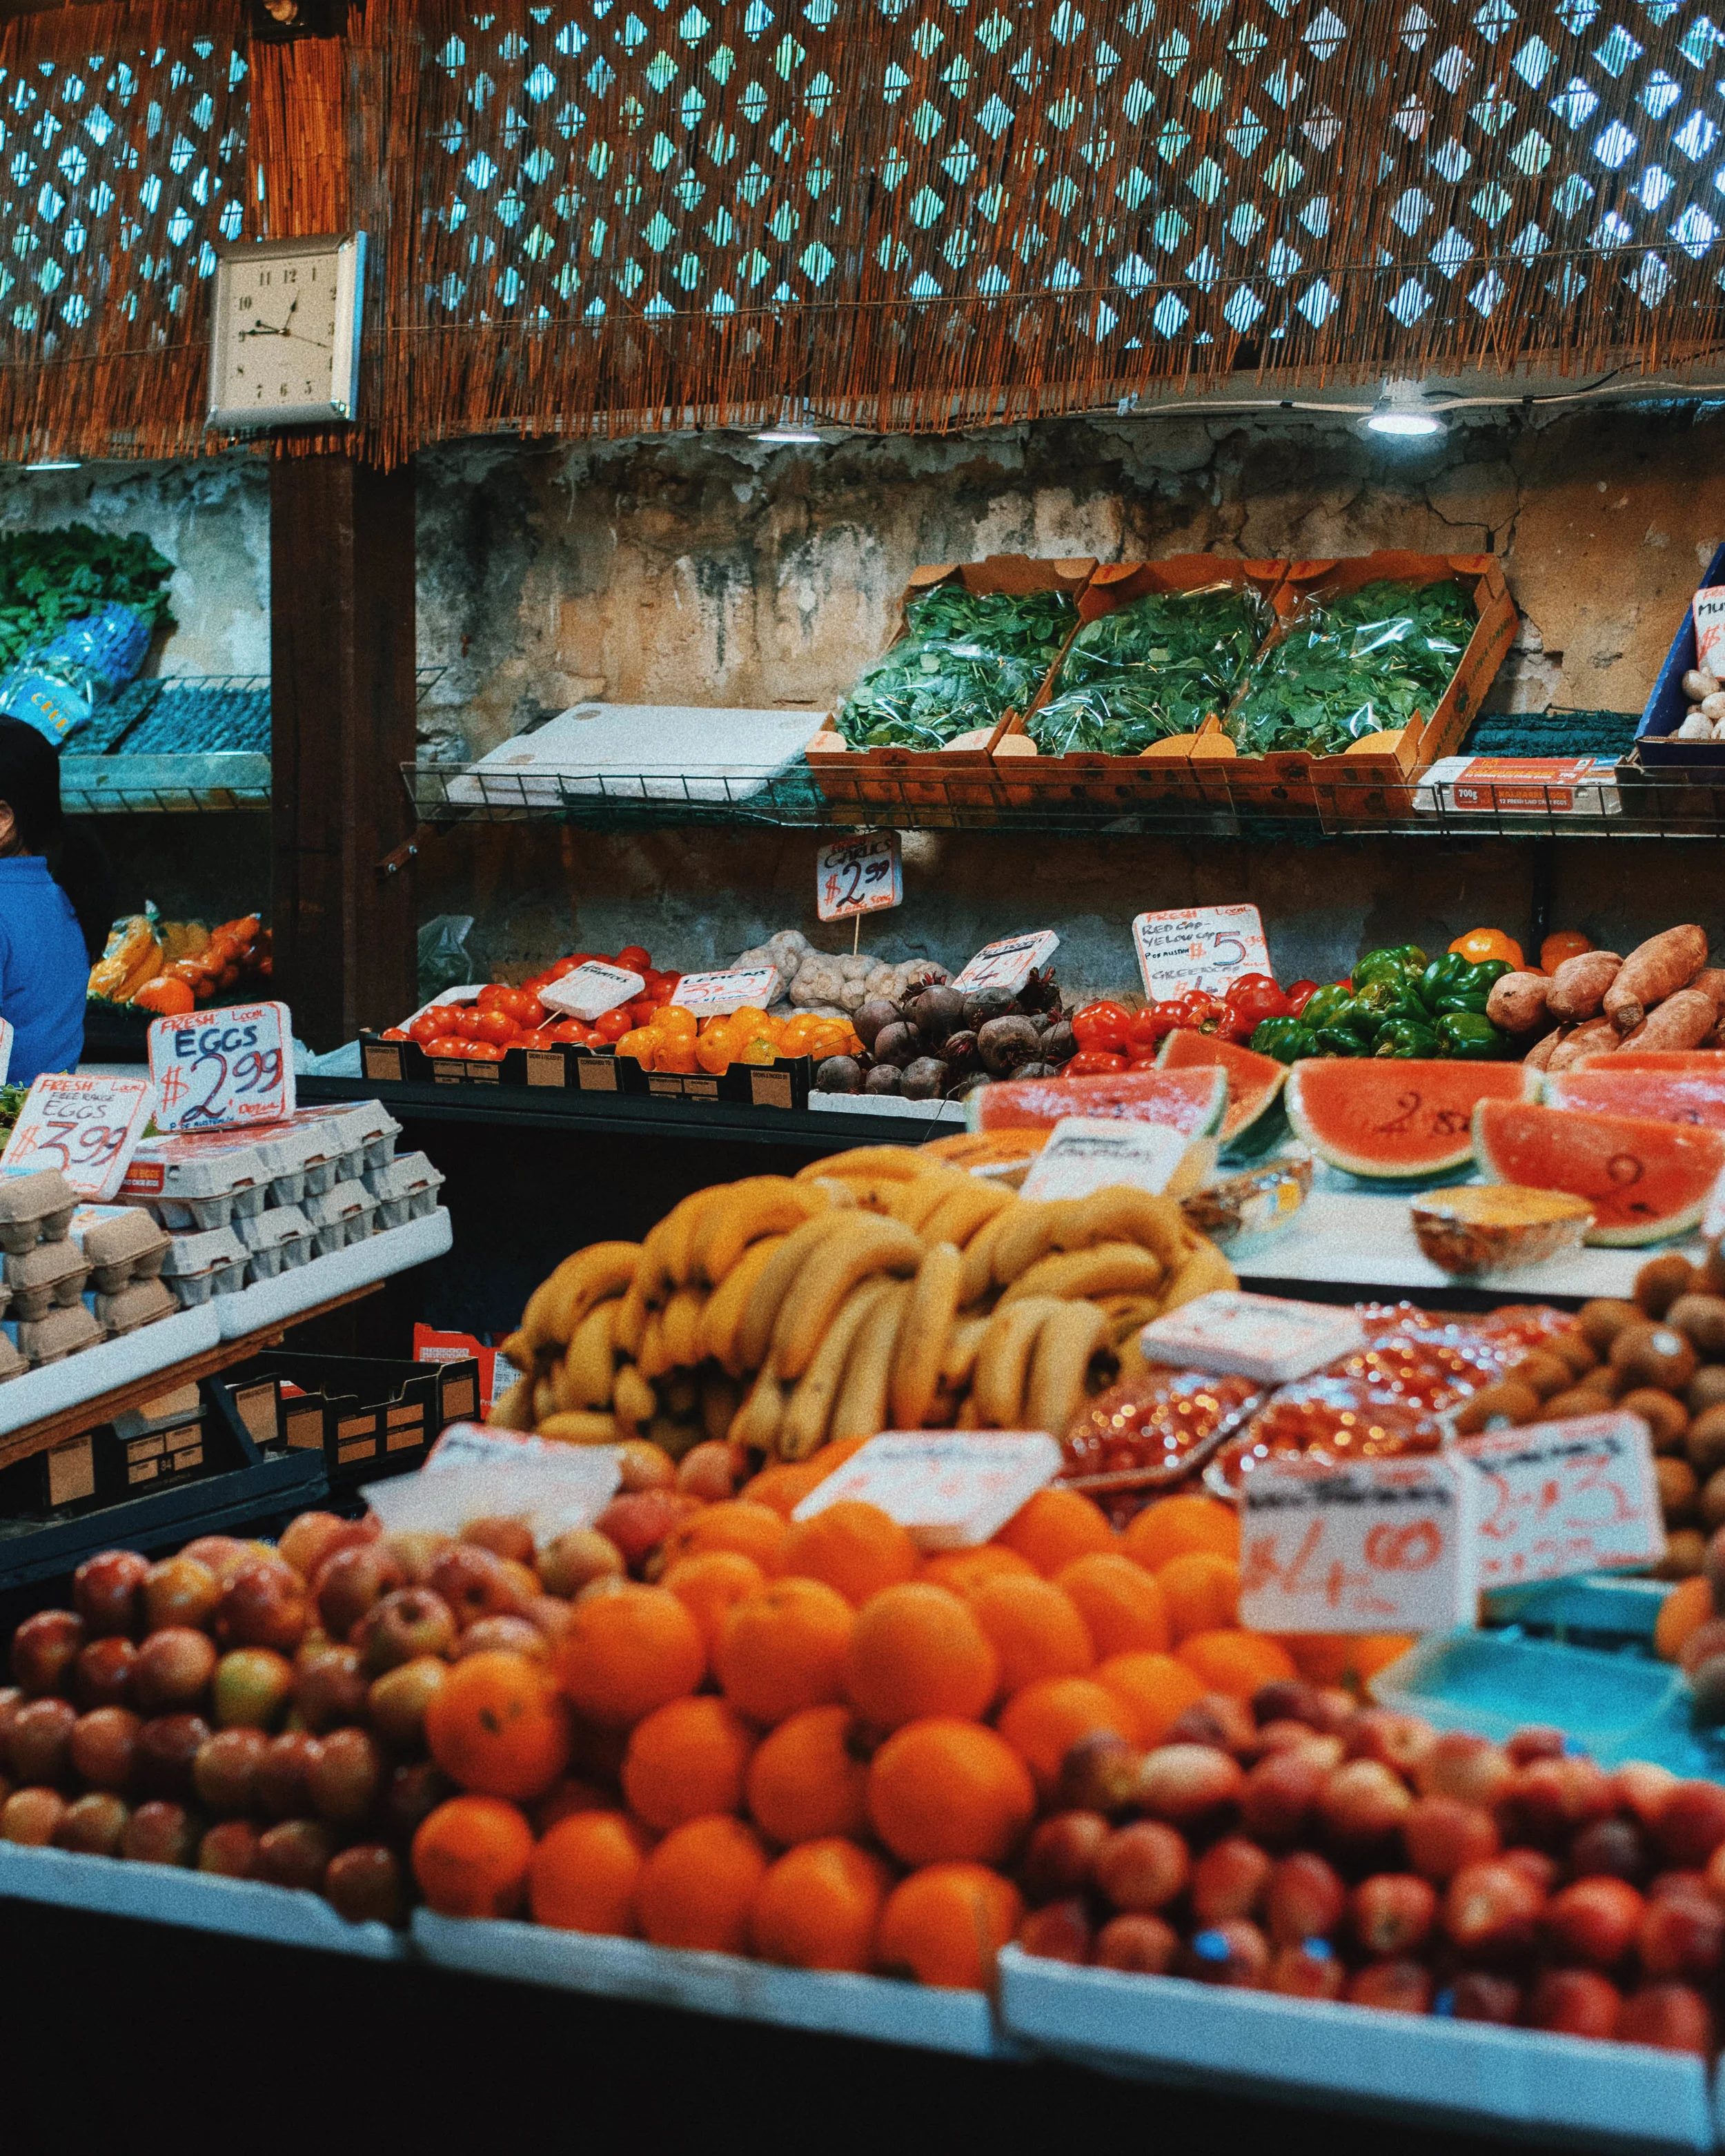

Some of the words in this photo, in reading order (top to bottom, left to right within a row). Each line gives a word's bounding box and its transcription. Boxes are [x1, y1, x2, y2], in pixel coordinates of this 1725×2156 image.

[259, 271, 270, 286] 11
[284, 268, 297, 284] 12
[312, 267, 316, 281] 1
[239, 296, 253, 310] 10
[1698, 603, 1725, 617] MU
[1458, 789, 1478, 800] 700g
[1142, 922, 1174, 936] RED
[682, 969, 768, 985] LEMONS
[175, 1025, 257, 1058] EGGS
[52, 1091, 79, 1101] FREE
[81, 1092, 116, 1102] RANGE
[43, 1100, 108, 1119] EGGS
